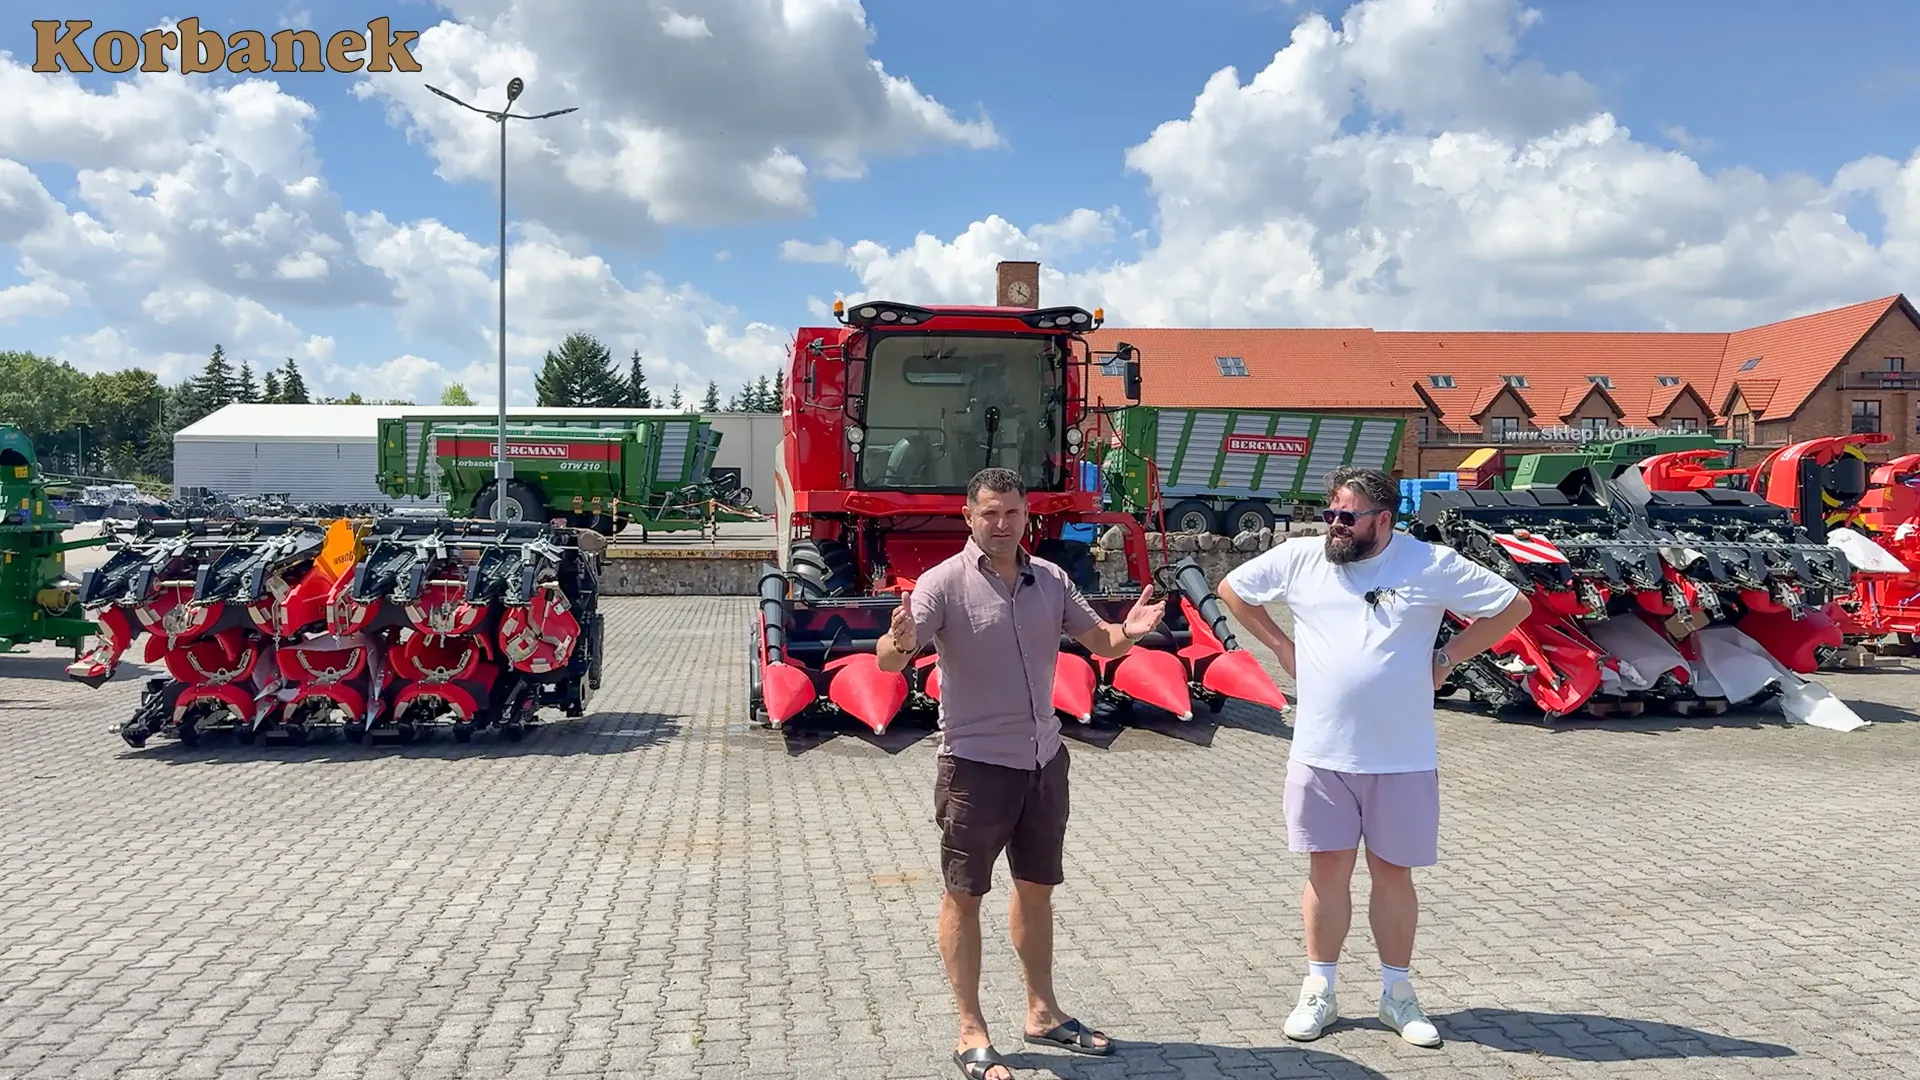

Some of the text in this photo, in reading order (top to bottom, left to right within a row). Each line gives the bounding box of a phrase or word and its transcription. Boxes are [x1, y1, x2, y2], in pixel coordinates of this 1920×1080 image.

[1231, 440, 1304, 452] BERGMANN
[560, 462, 601, 471] GTW 210
